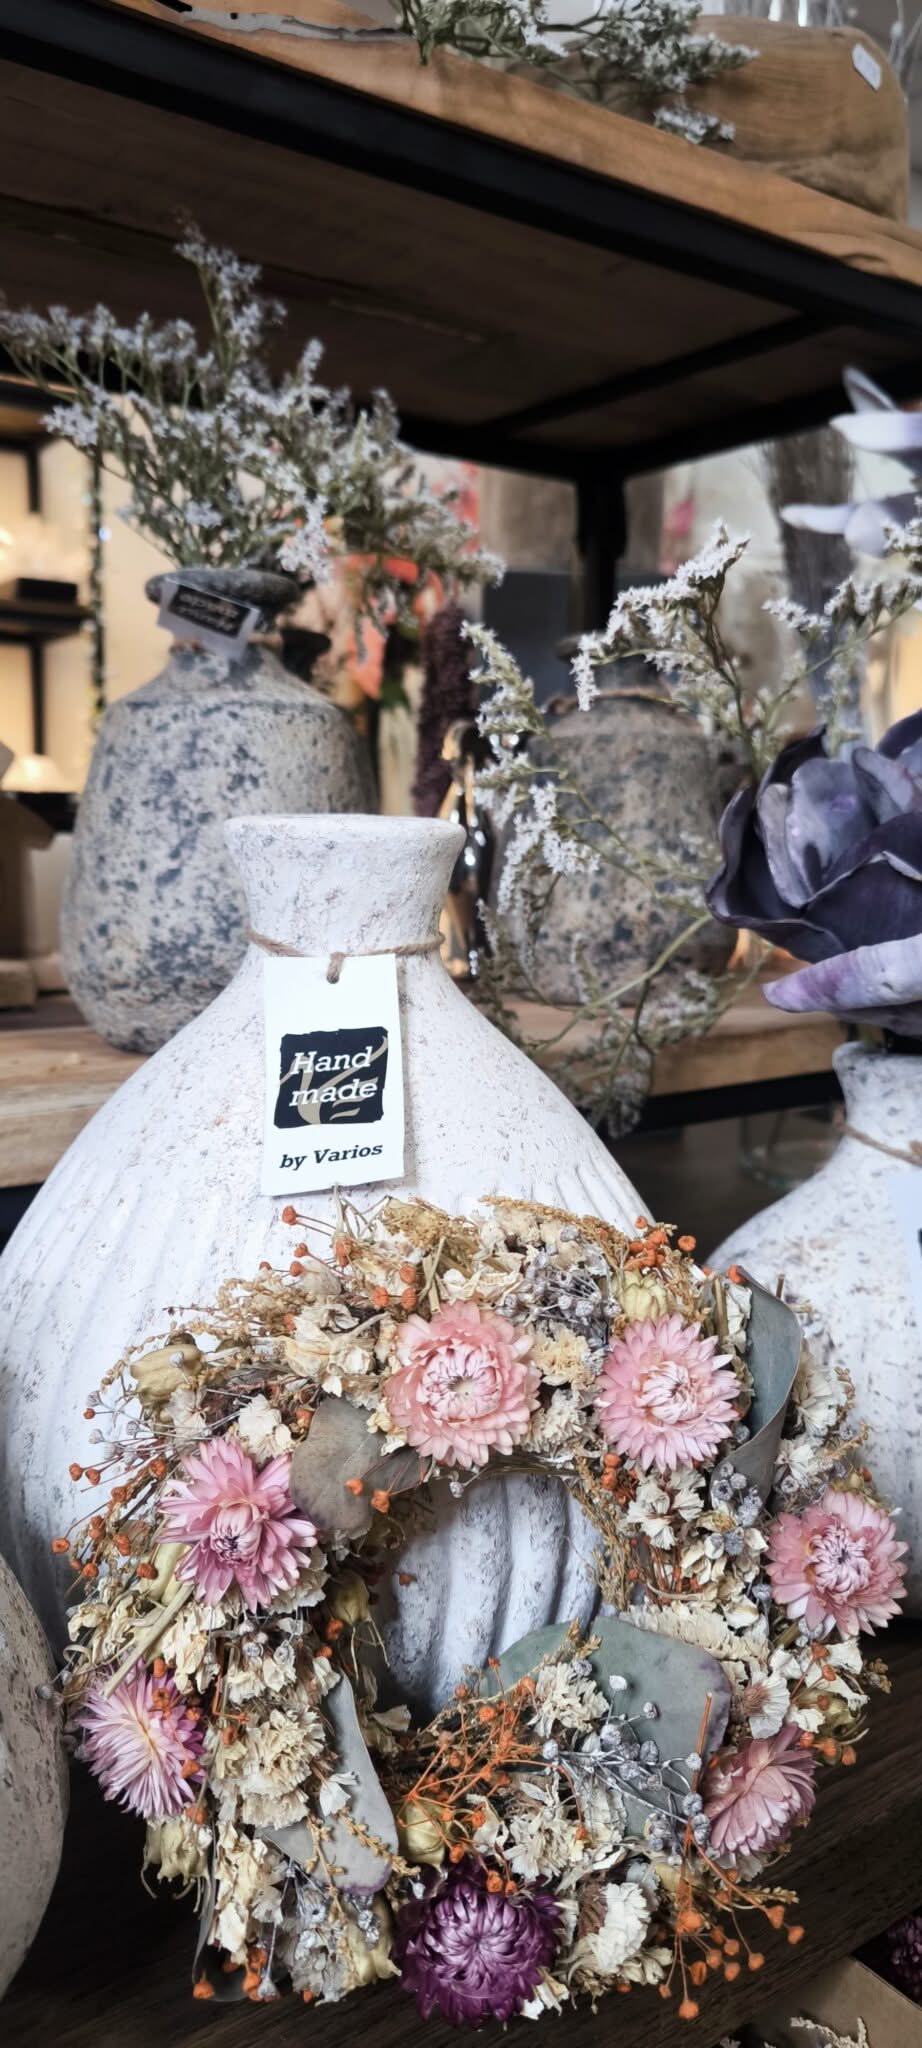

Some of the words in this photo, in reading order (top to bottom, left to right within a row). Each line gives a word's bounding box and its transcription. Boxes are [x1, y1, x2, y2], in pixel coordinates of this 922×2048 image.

[292, 1046, 373, 1075] Hand
[289, 1078, 378, 1106] made
[279, 1154, 307, 1170] by
[314, 1144, 383, 1164] Varios
